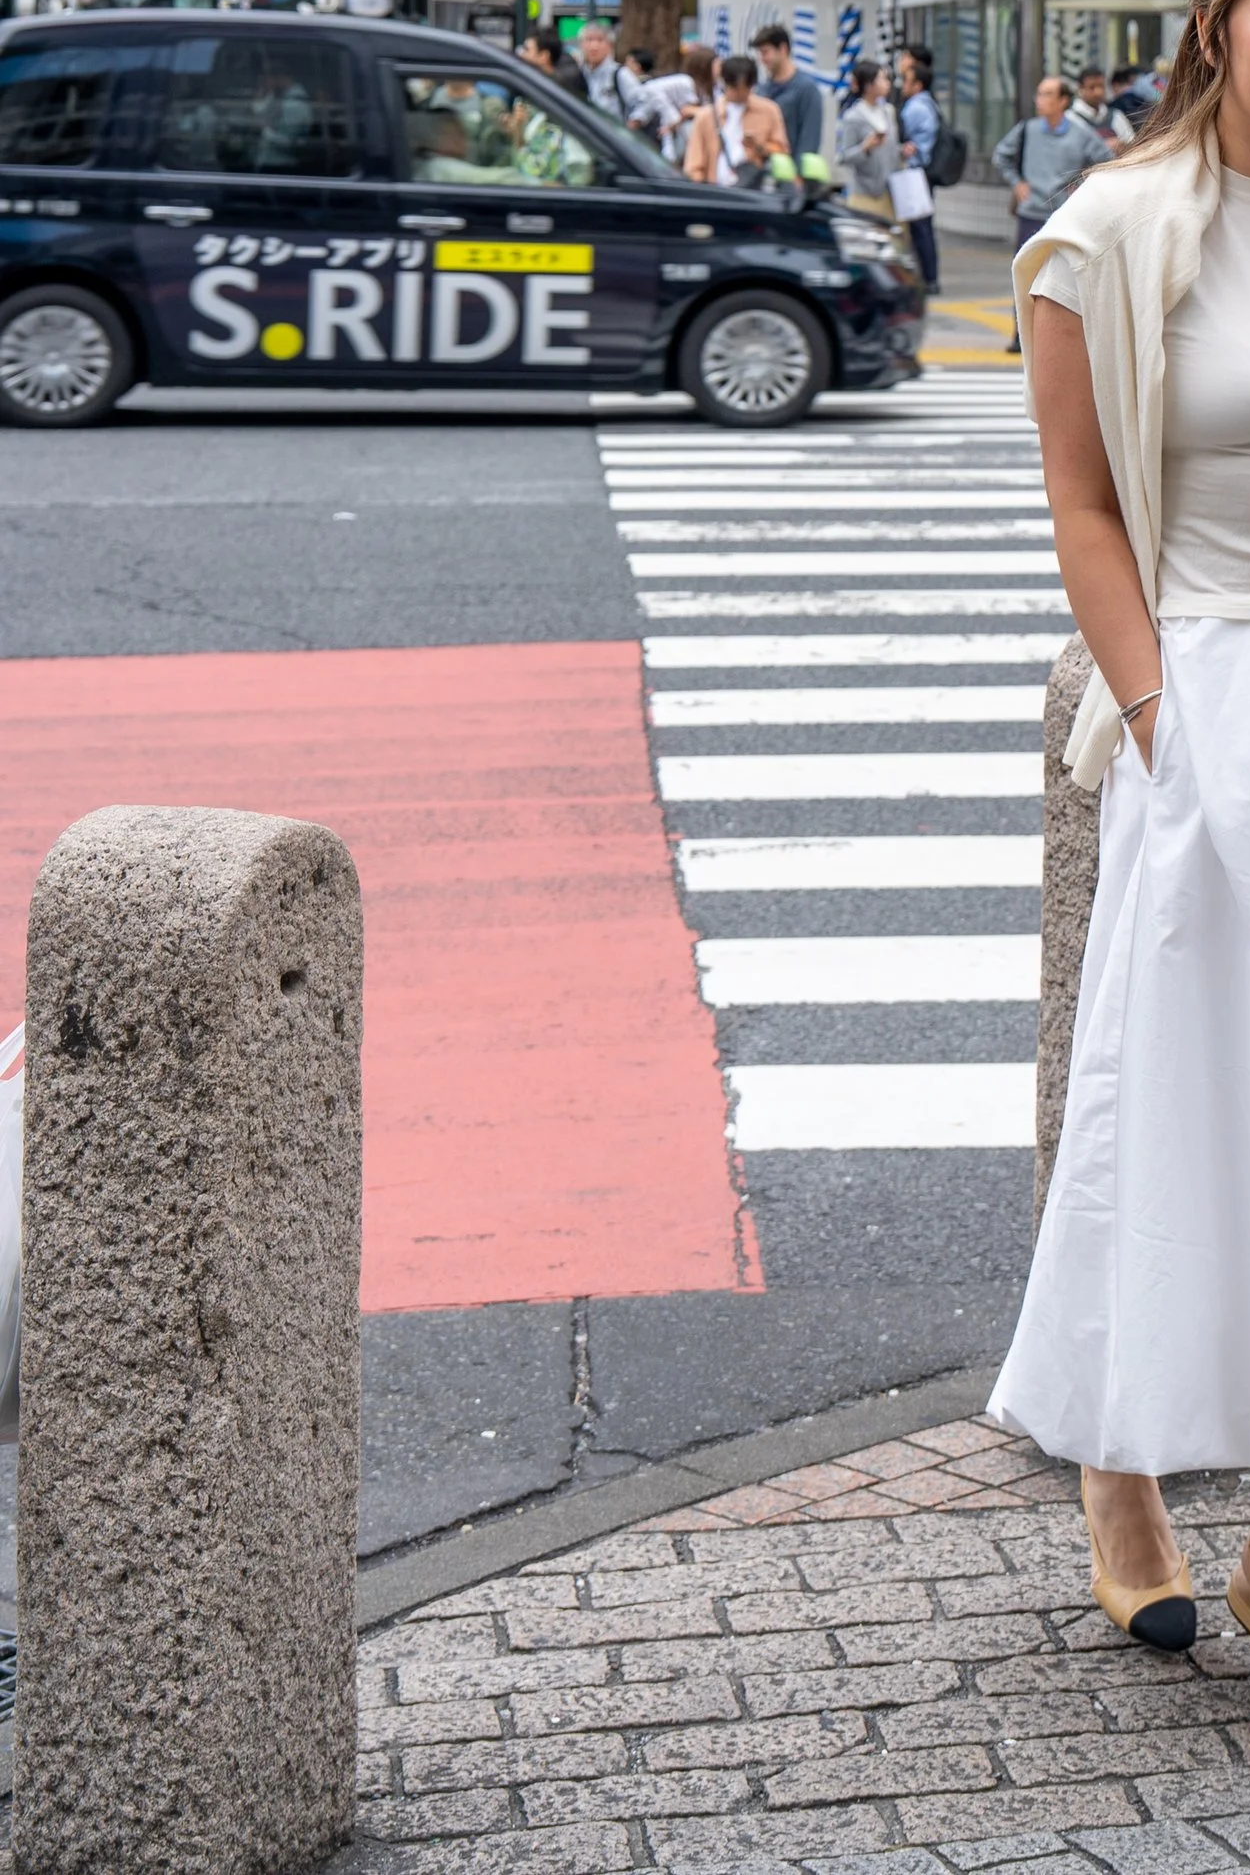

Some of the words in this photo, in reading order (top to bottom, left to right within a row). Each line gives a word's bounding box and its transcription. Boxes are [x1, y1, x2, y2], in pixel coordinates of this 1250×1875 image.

[193, 234, 427, 269] タクシーアプリ
[464, 246, 563, 265] エスライド
[187, 265, 593, 366] S.RIDE
